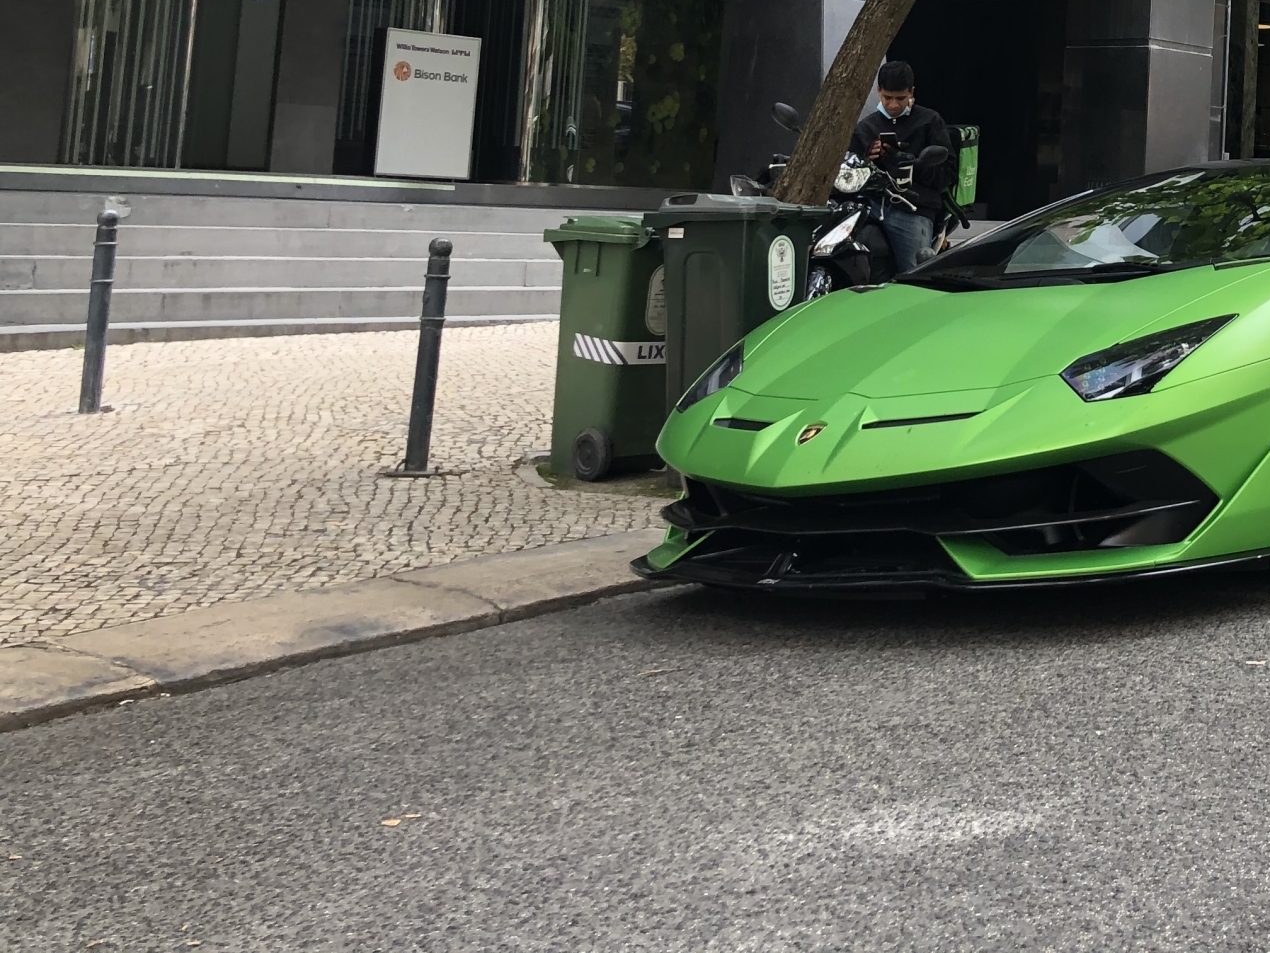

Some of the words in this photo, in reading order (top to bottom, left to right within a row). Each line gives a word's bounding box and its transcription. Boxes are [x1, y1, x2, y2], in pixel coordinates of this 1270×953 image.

[414, 69, 441, 81] Bison
[444, 72, 468, 83] Bank
[637, 345, 666, 360] LIX
